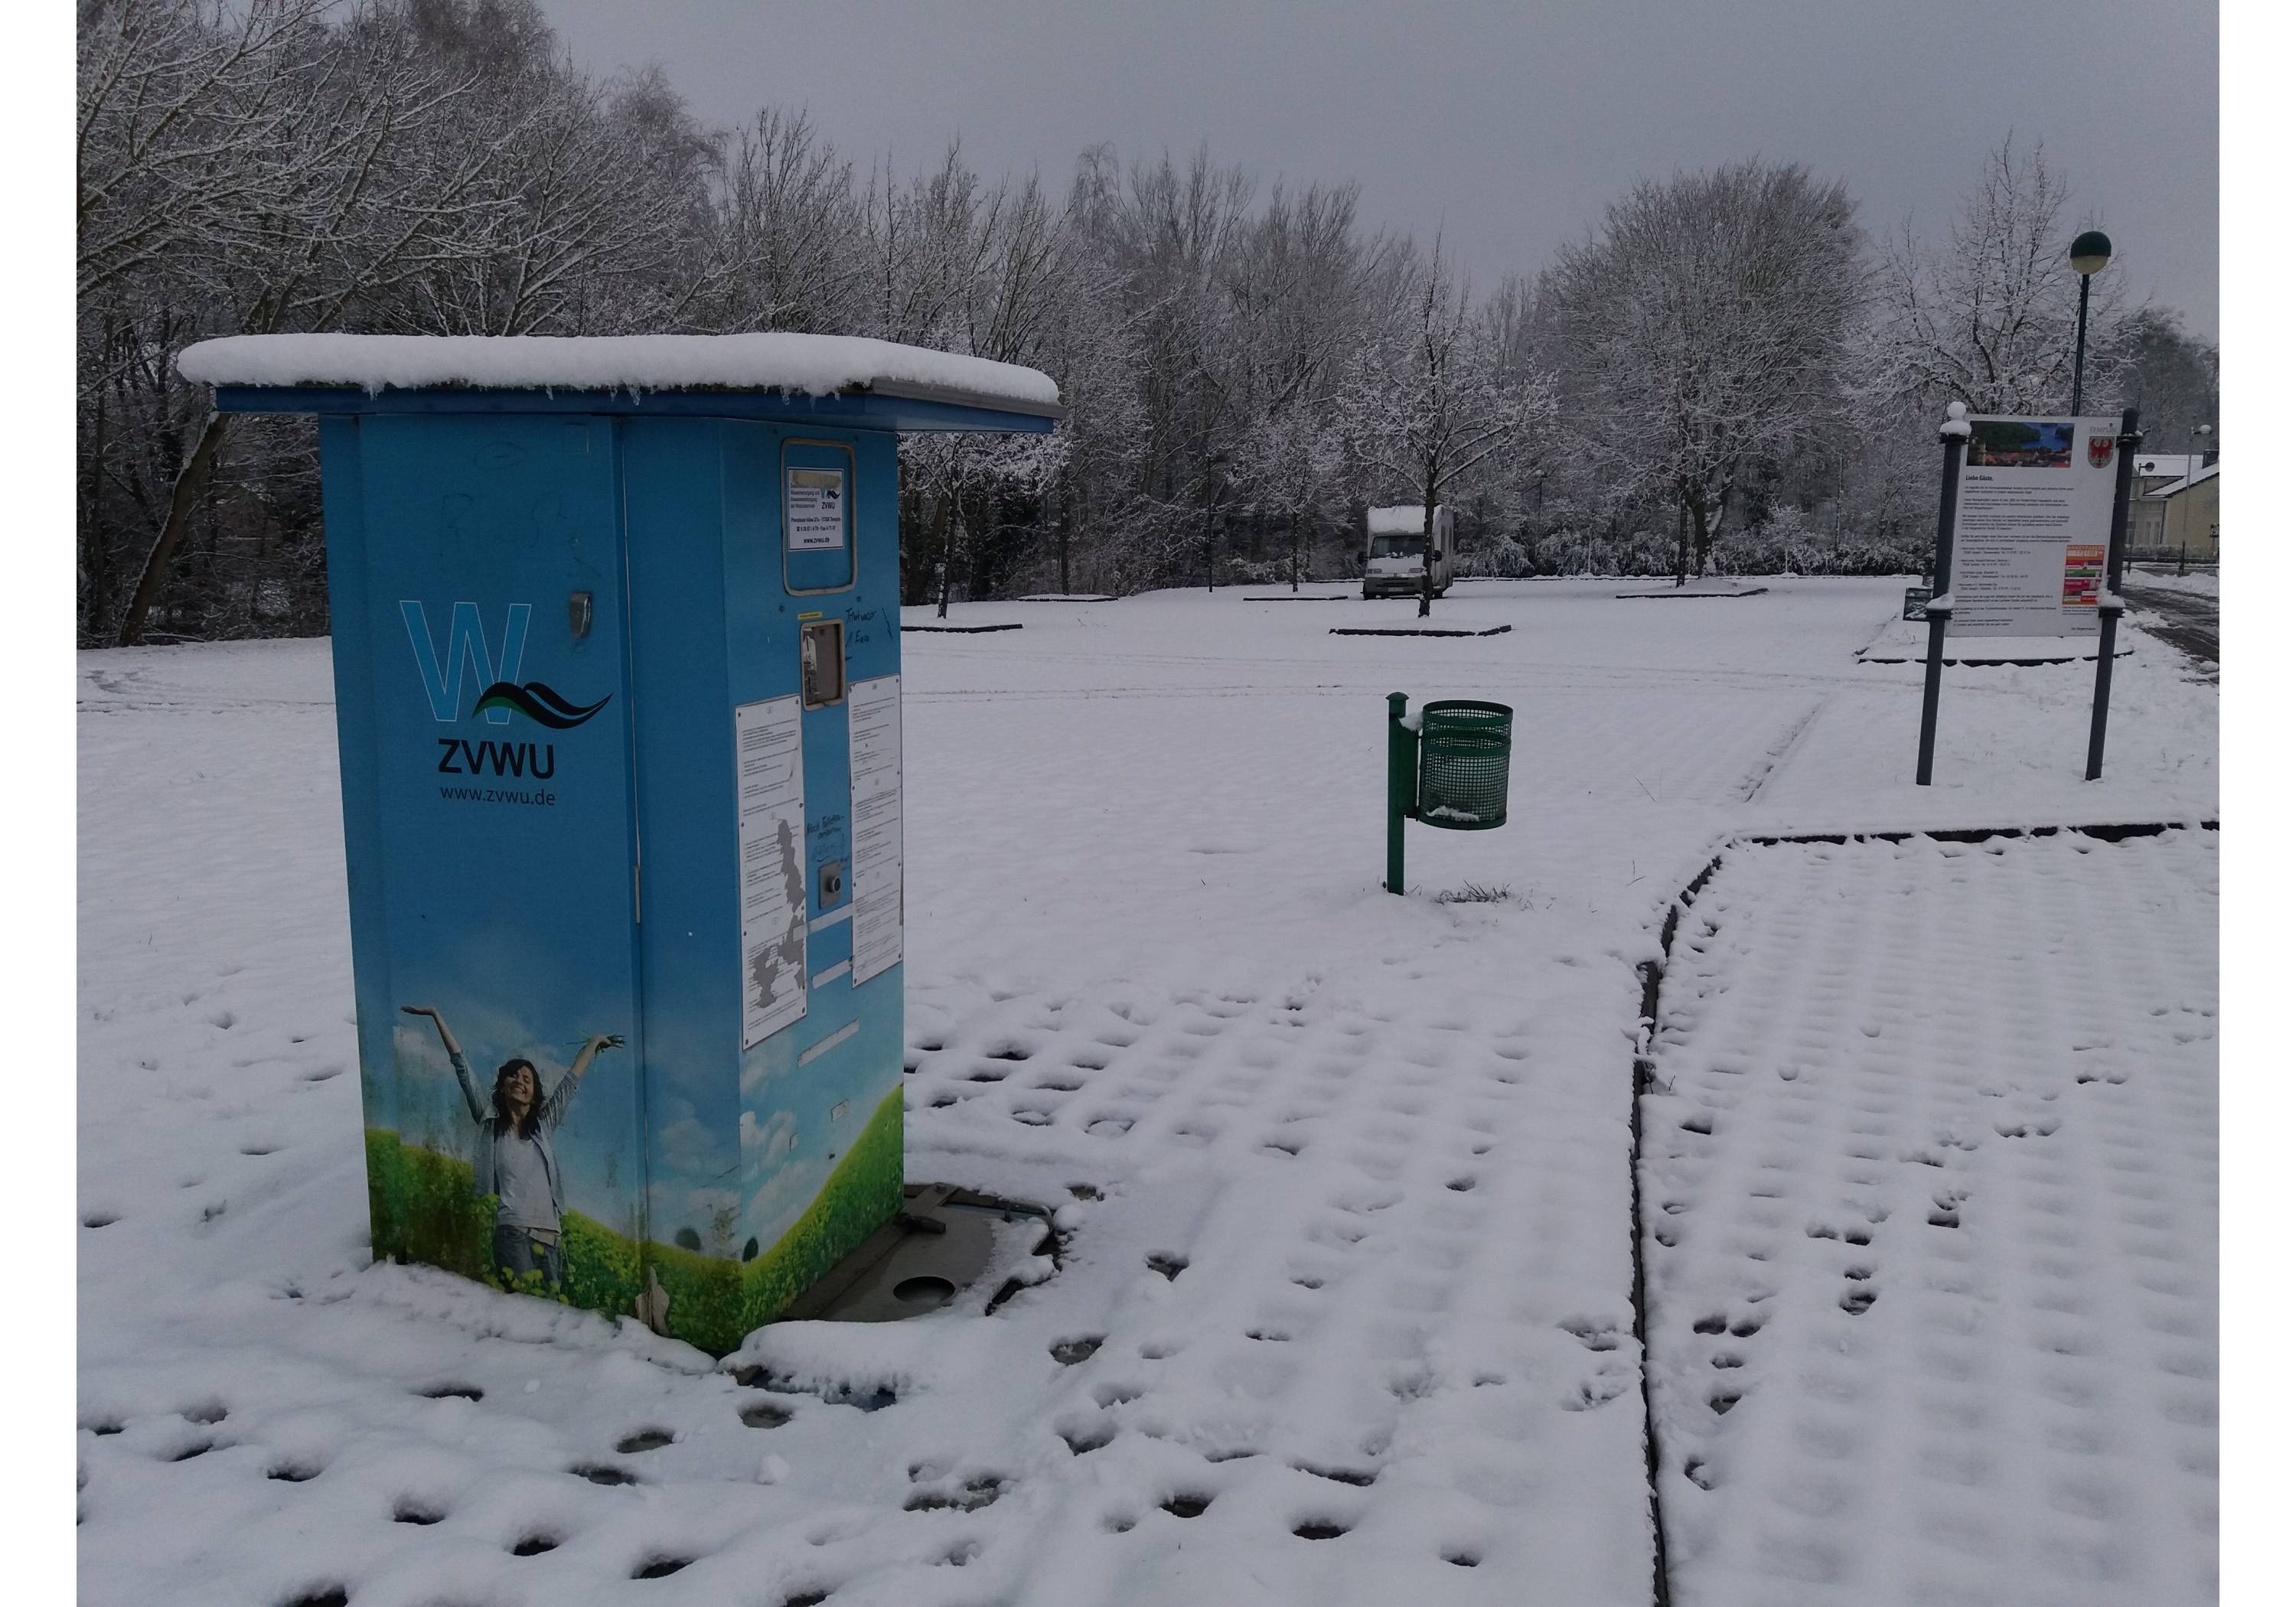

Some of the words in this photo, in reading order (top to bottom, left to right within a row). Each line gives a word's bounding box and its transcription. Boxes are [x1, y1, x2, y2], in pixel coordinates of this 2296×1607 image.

[399, 600, 532, 725] W
[438, 738, 555, 779] ZVWU
[440, 787, 556, 806] www.zvwu.de
